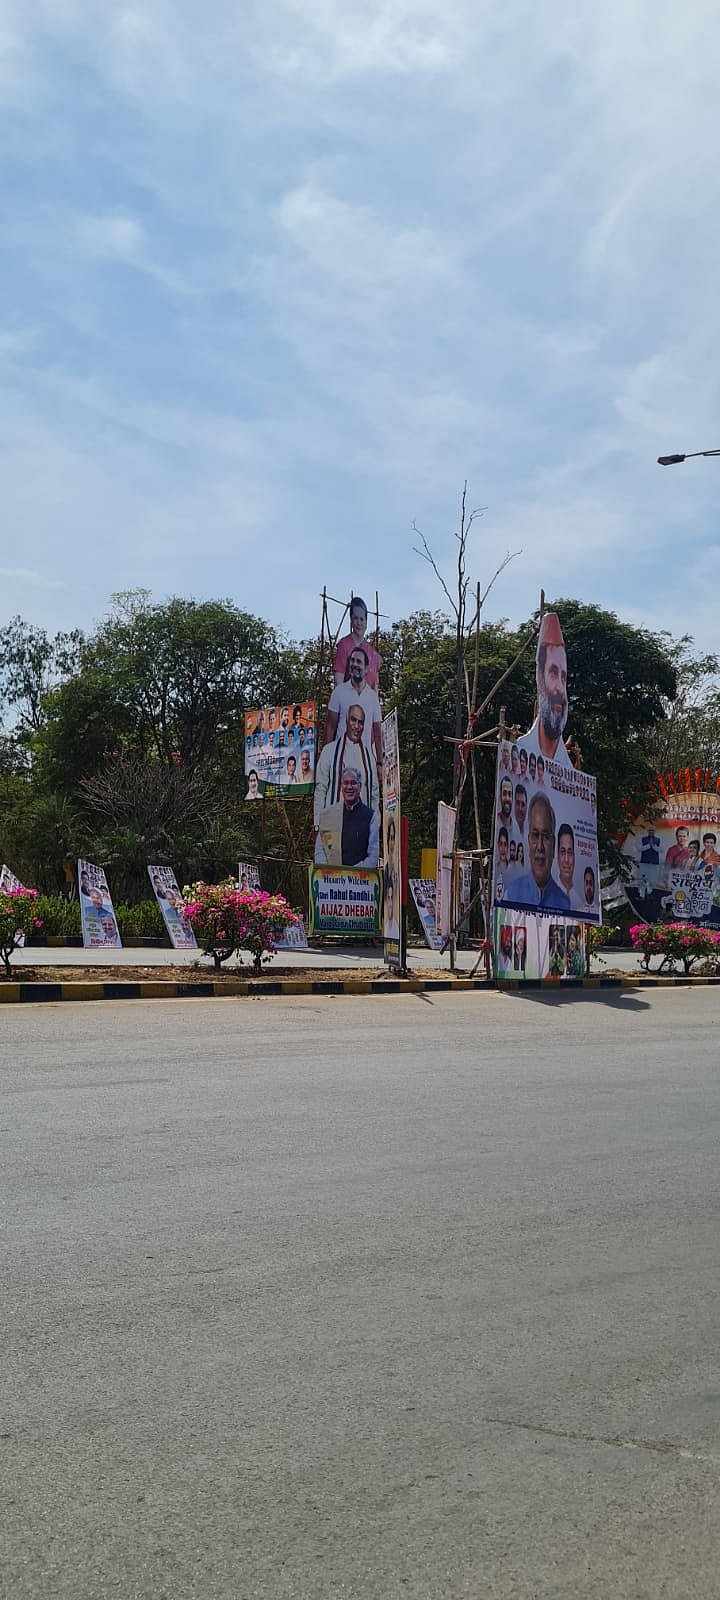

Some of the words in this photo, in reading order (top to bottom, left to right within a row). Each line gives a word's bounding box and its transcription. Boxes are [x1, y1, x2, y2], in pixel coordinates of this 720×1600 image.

[329, 888, 348, 900] Rahul
[349, 890, 370, 901] Gandhi
[691, 891, 705, 900] 85
[320, 903, 344, 916] AIJAZ
[345, 904, 374, 917] DHEBAR
